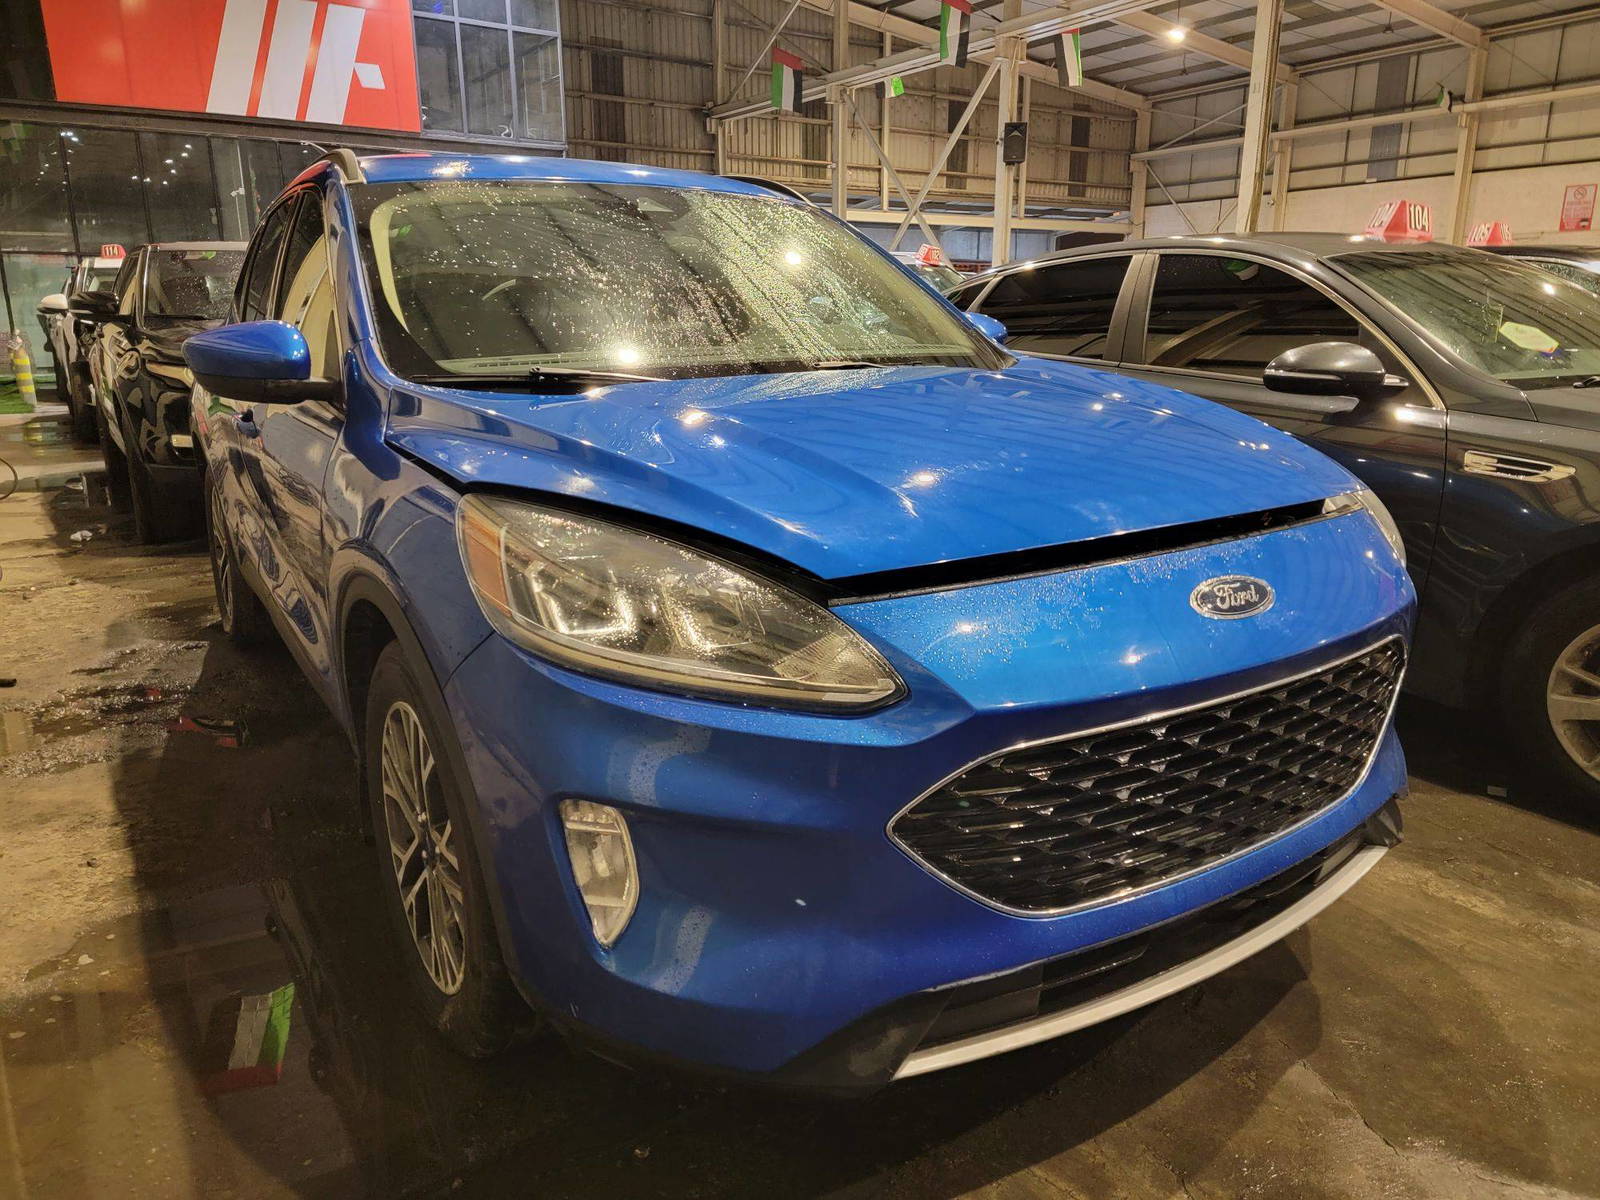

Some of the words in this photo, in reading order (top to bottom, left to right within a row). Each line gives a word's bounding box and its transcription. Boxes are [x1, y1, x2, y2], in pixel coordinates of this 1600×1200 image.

[1409, 203, 1429, 232] 104
[105, 246, 118, 257] 114
[1213, 583, 1259, 609] Ford
